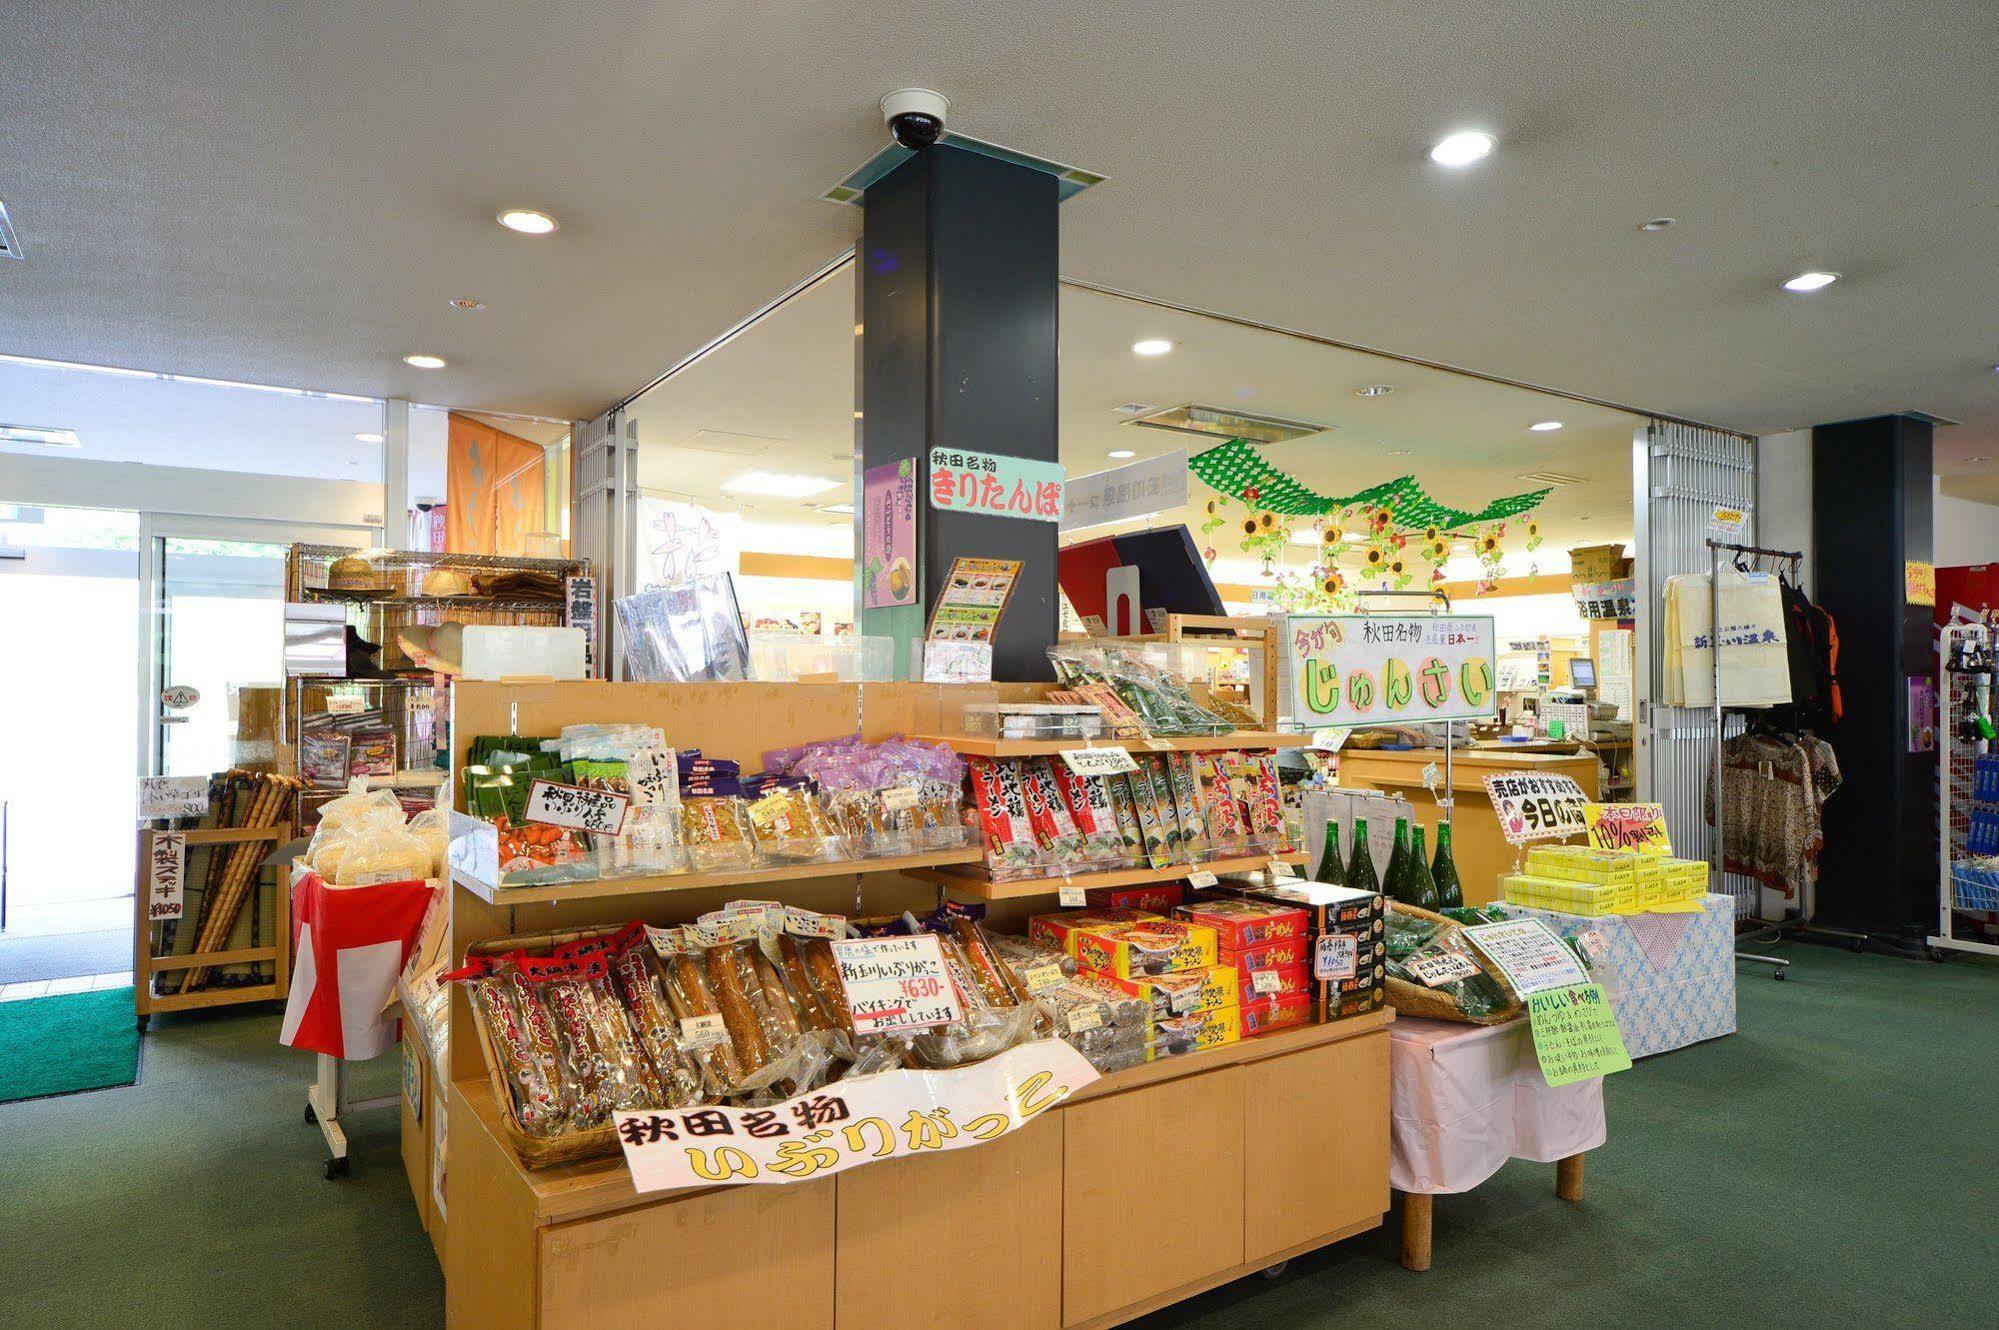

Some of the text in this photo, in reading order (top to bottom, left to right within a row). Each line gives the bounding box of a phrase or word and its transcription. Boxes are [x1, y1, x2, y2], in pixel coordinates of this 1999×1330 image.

[931, 450, 997, 473] 秋田名物
[931, 467, 1062, 517] きりたんぽ
[1295, 620, 1343, 658] 今が旬
[1363, 621, 1422, 643] 秋田名物
[1306, 656, 1495, 714] じゅんさい
[541, 785, 616, 810] 秋田特産品
[982, 771, 1002, 818] ラーメン
[1022, 773, 1045, 816] ラーメン
[1491, 776, 1581, 799] 売店がおすすめする
[1590, 820, 1663, 850] 10%割引
[841, 961, 940, 981] 新玉川いぶりがっこ
[852, 997, 917, 1015] バイキングで
[873, 1006, 953, 1028] お出ししています
[619, 1095, 850, 1147] 秋田名物
[684, 1069, 1069, 1182] いぶりがっこ
